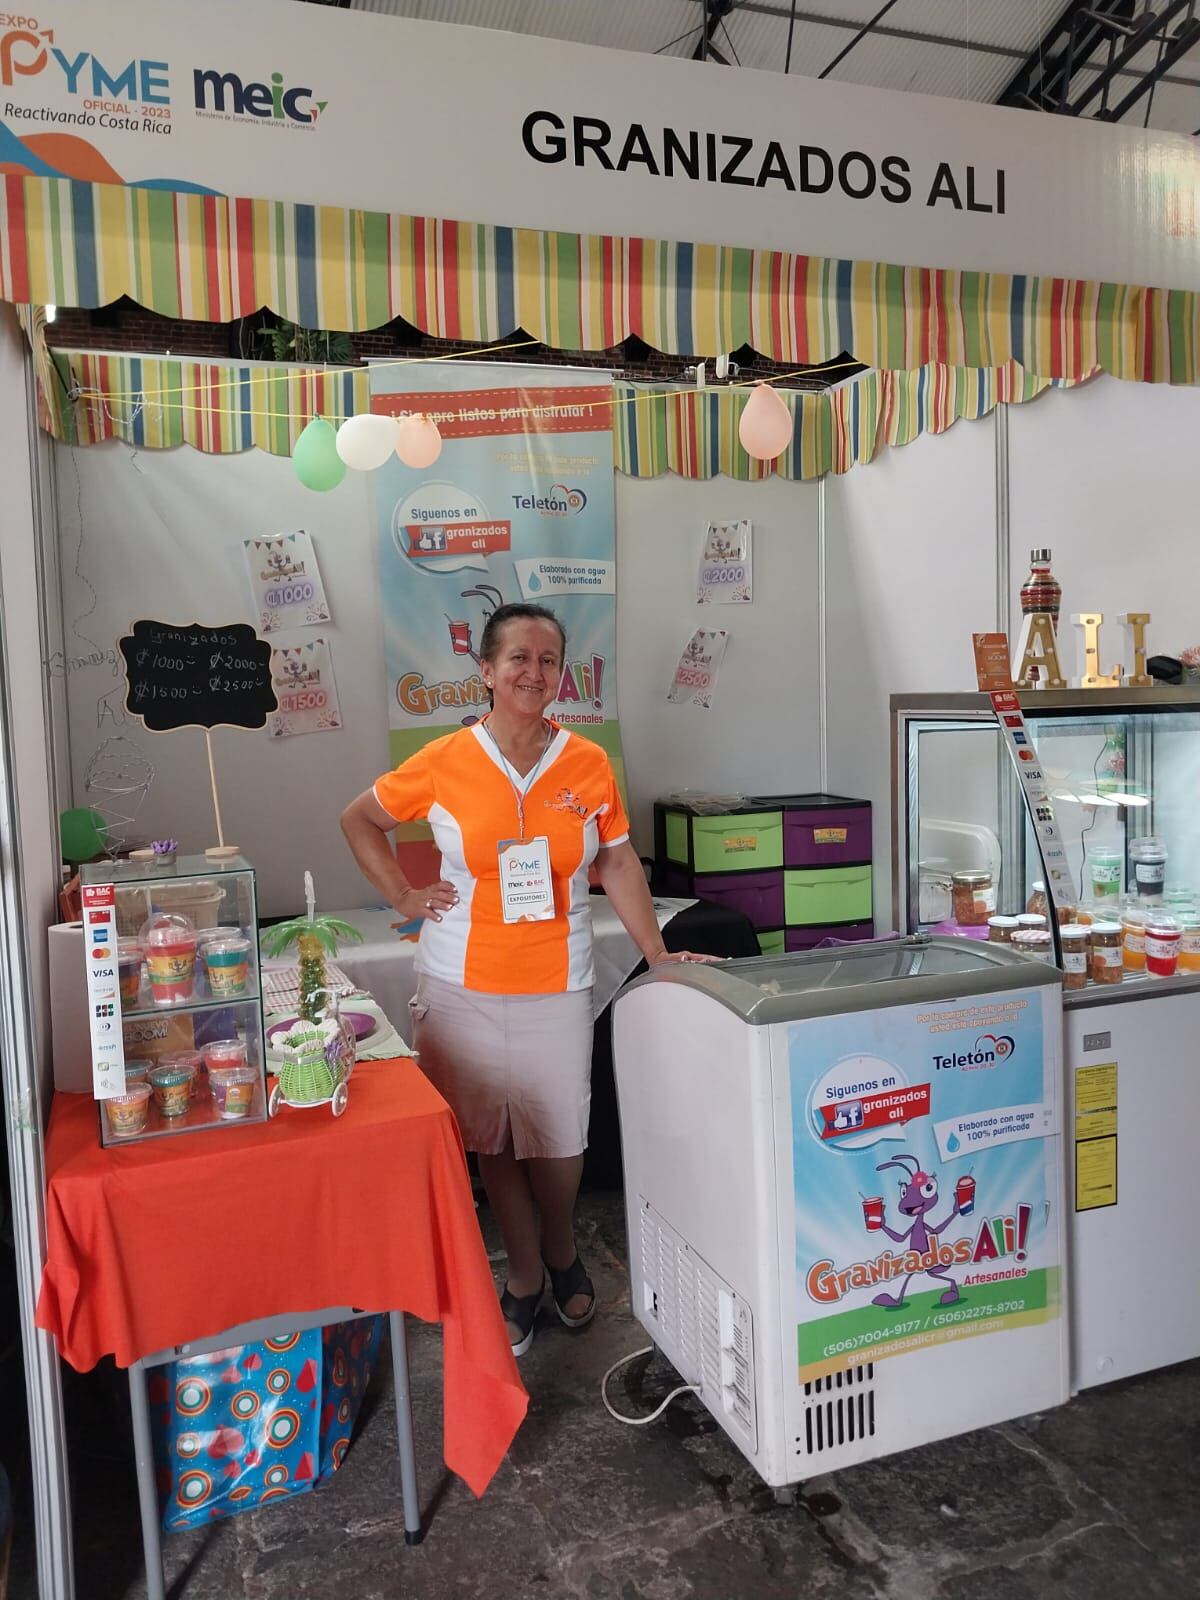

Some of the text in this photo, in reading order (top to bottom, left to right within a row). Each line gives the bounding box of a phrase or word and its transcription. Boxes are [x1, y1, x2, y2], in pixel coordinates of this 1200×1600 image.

[0, 14, 38, 30] EXPO
[0, 30, 170, 105] PYME
[193, 69, 314, 123] meic
[83, 99, 130, 114] OFICIAL
[141, 106, 171, 119] 2023
[4, 103, 171, 135] Reactivando Costa Rica
[521, 109, 1006, 215] GRANIZADOS ALI
[459, 407, 496, 422] listos
[500, 407, 529, 423] para
[533, 404, 585, 419] disfrutar
[511, 495, 568, 511] Teletón
[464, 507, 477, 517] en
[446, 525, 508, 540] granizados
[471, 539, 486, 549] ali
[539, 564, 606, 576] Elaborado con agua
[547, 575, 602, 585] 100% purificada
[151, 629, 237, 646] Granizados
[556, 652, 605, 711] Ali!
[550, 712, 604, 725] Artesanales
[1024, 770, 1041, 779] VISA
[510, 860, 541, 871] PYME
[509, 894, 545, 902] EXPOSITORES
[93, 968, 114, 978] VISA
[932, 1049, 995, 1070] Teletón
[882, 1075, 896, 1087] en
[863, 1089, 928, 1114] granizados
[889, 1107, 904, 1120] ali
[958, 1111, 1035, 1132] Elaborado con agua
[967, 1122, 1030, 1142] 100% purificada
[963, 1267, 1028, 1286] Artesanales
[823, 1319, 920, 1357] (506)7004-9177
[933, 1300, 1025, 1327] (506)2275-8702
